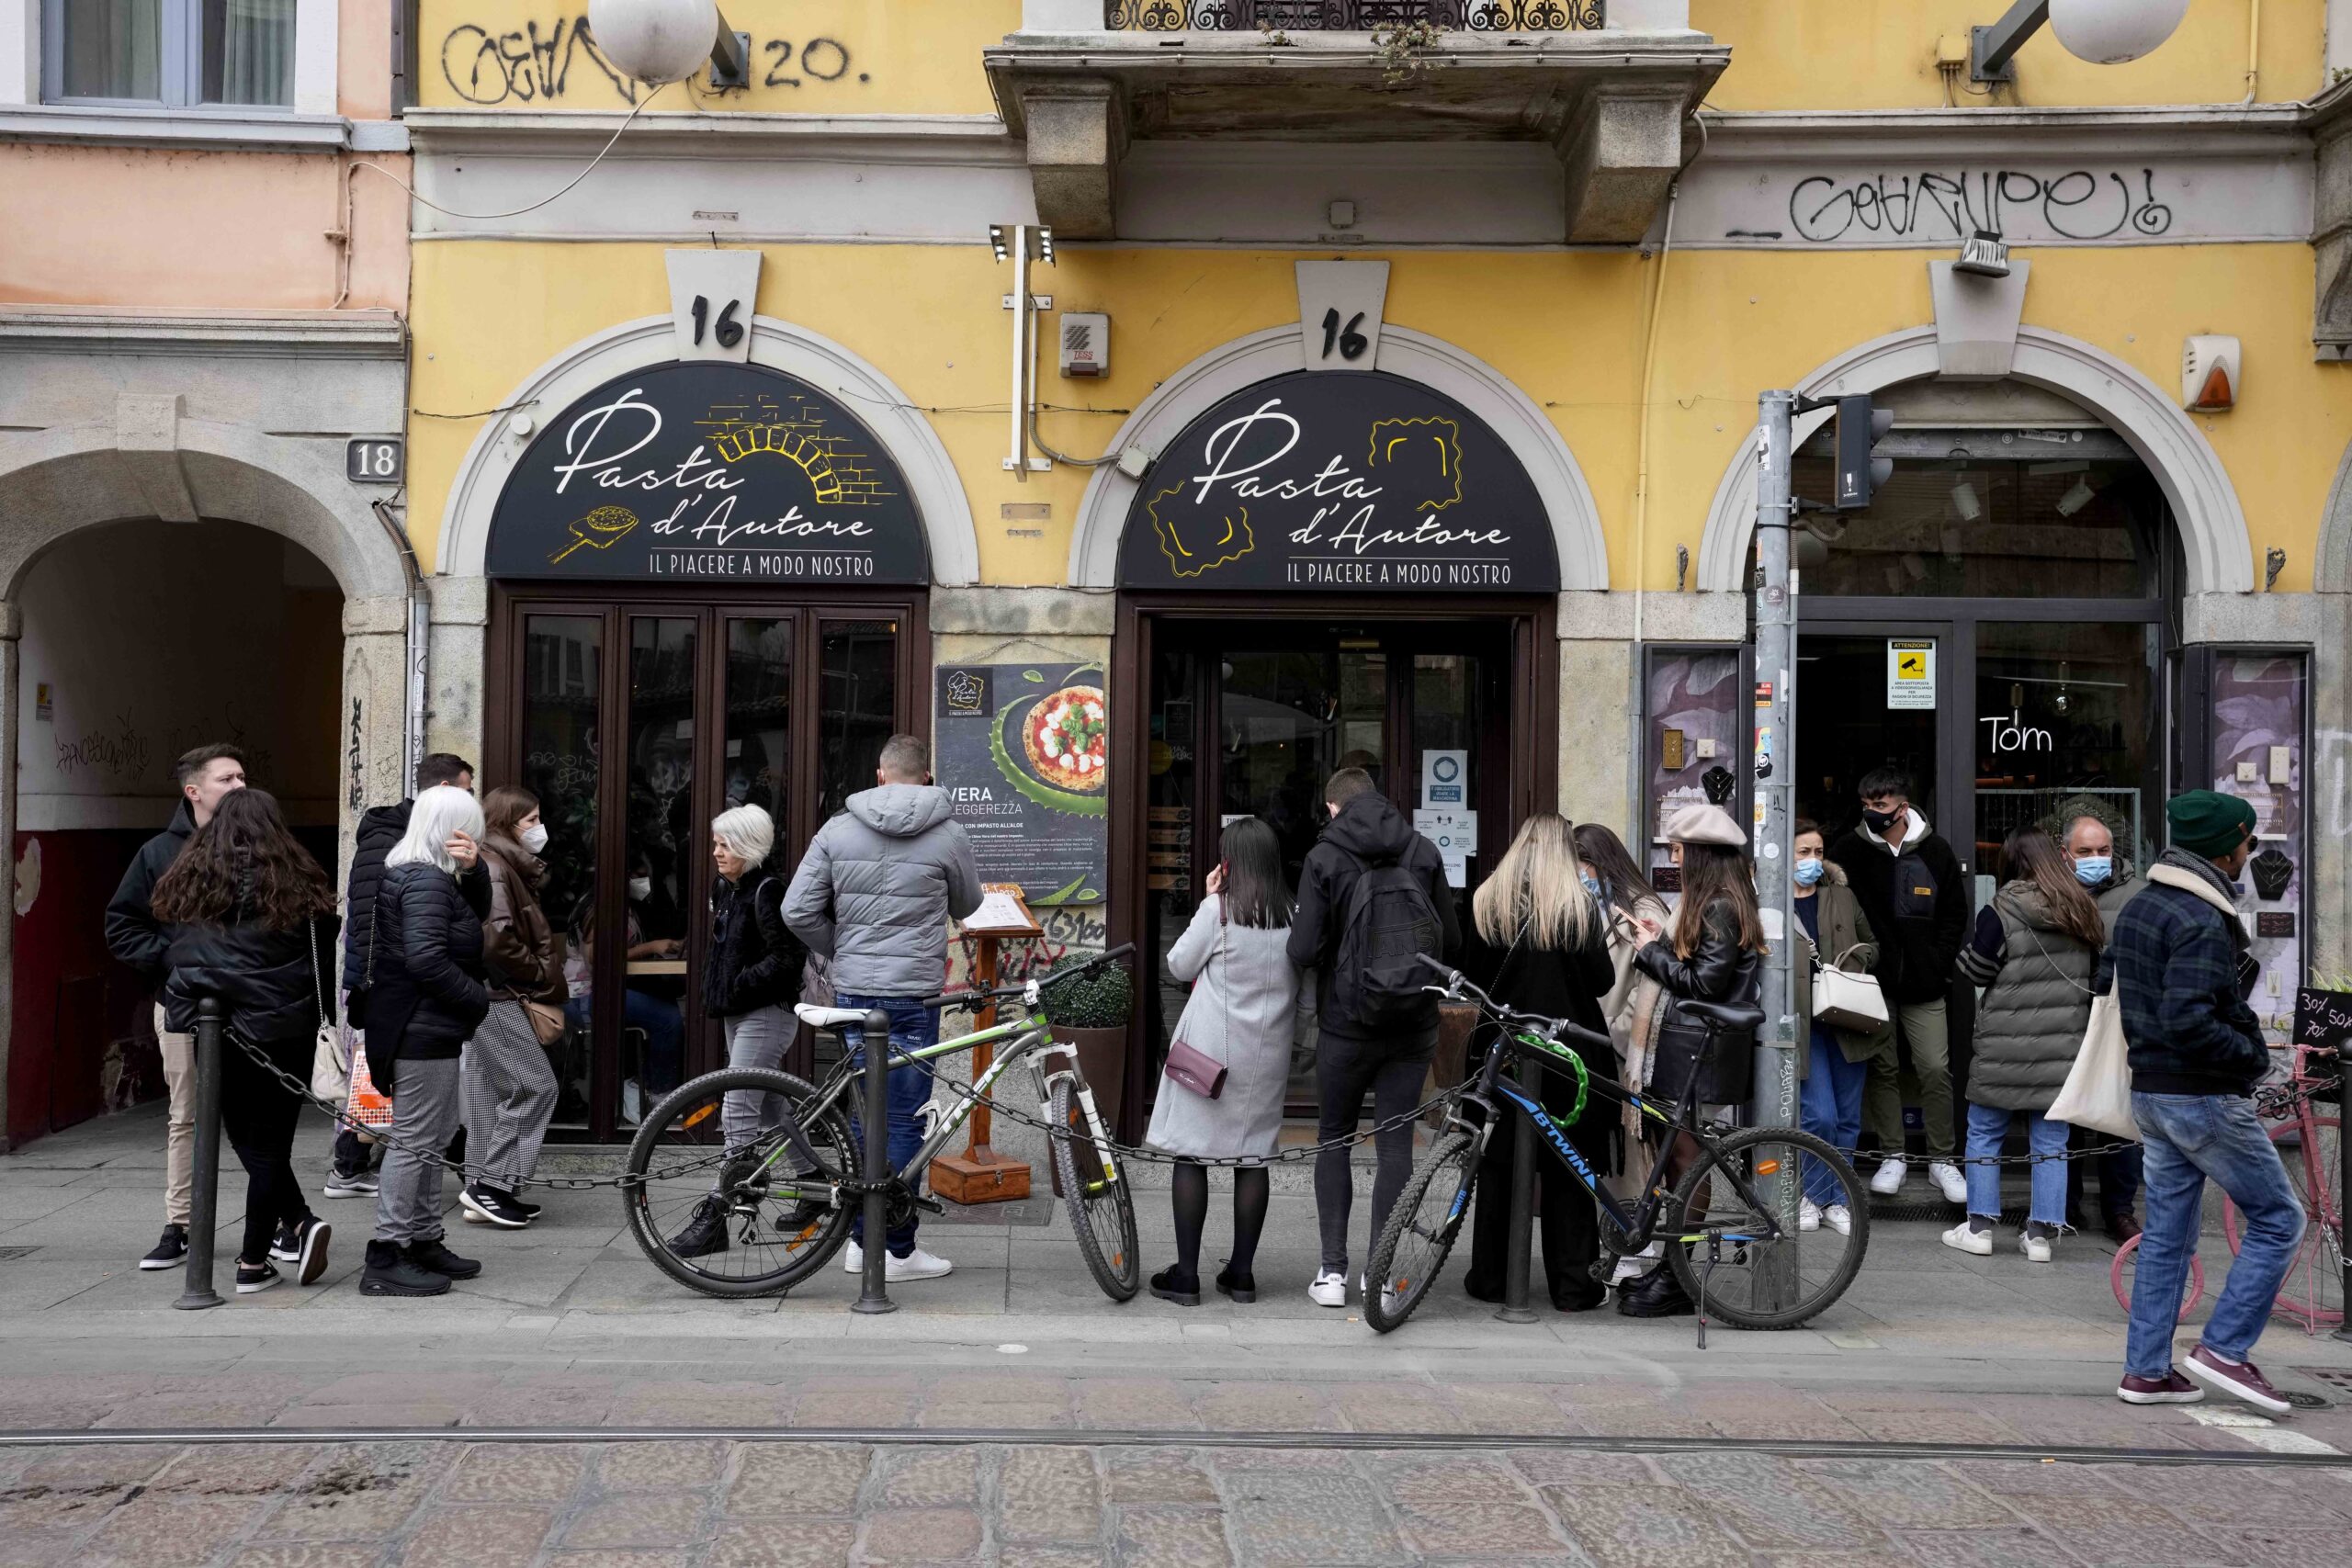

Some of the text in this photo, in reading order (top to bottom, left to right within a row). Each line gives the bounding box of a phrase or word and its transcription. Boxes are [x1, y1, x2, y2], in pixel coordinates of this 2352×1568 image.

[690, 294, 745, 348] 16
[1321, 307, 1369, 360] 16
[356, 444, 396, 477] 18
[553, 388, 745, 495] Pasta
[1193, 398, 1384, 504] Pasta
[650, 493, 874, 547] d'Autore
[1288, 502, 1511, 555] d'Autore
[650, 554, 874, 576] IL PIACERE A MODO NOSTRO
[1287, 563, 1510, 584] IL PIACERE A MODO NOSTRO
[950, 787, 992, 802] VERA
[2301, 993, 2329, 1014] 30%
[2305, 1020, 2328, 1038] 70%
[936, 1059, 1005, 1134] TREK
[1532, 1111, 1591, 1176] B'TWIN
